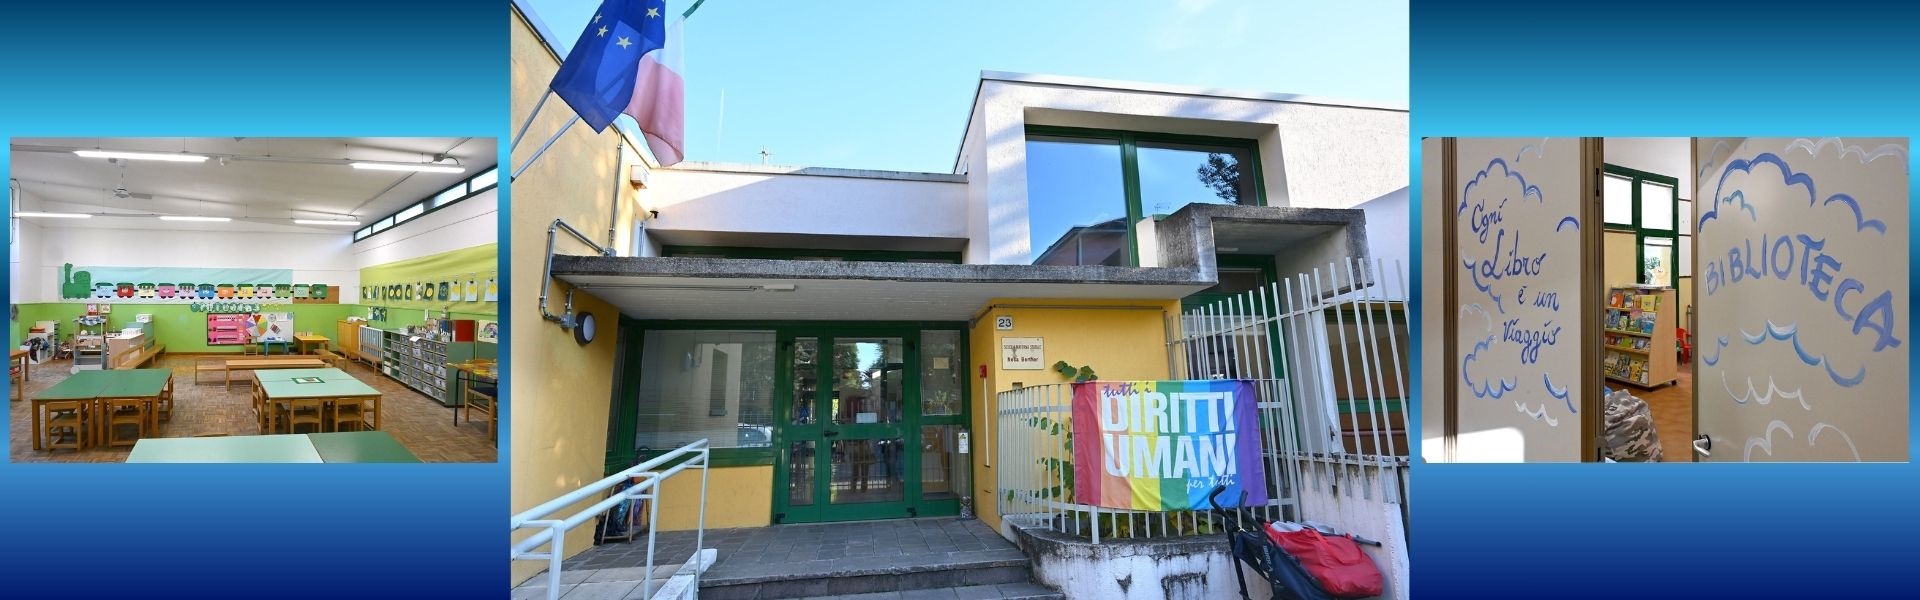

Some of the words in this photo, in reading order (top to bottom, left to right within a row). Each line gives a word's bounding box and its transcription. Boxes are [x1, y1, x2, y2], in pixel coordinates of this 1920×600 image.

[1481, 229, 1546, 280] Libro
[1533, 291, 1560, 312] un
[1705, 233, 1902, 352] BIBLIOTECA
[998, 318, 1012, 328] 23
[1503, 318, 1562, 364] Viaggio
[1103, 382, 1139, 397] tutti
[1144, 381, 1152, 393] i
[1101, 391, 1235, 433] DIRITTI
[1103, 433, 1237, 479] UMANI
[1186, 478, 1205, 495] per
[1208, 472, 1235, 489] tutti
